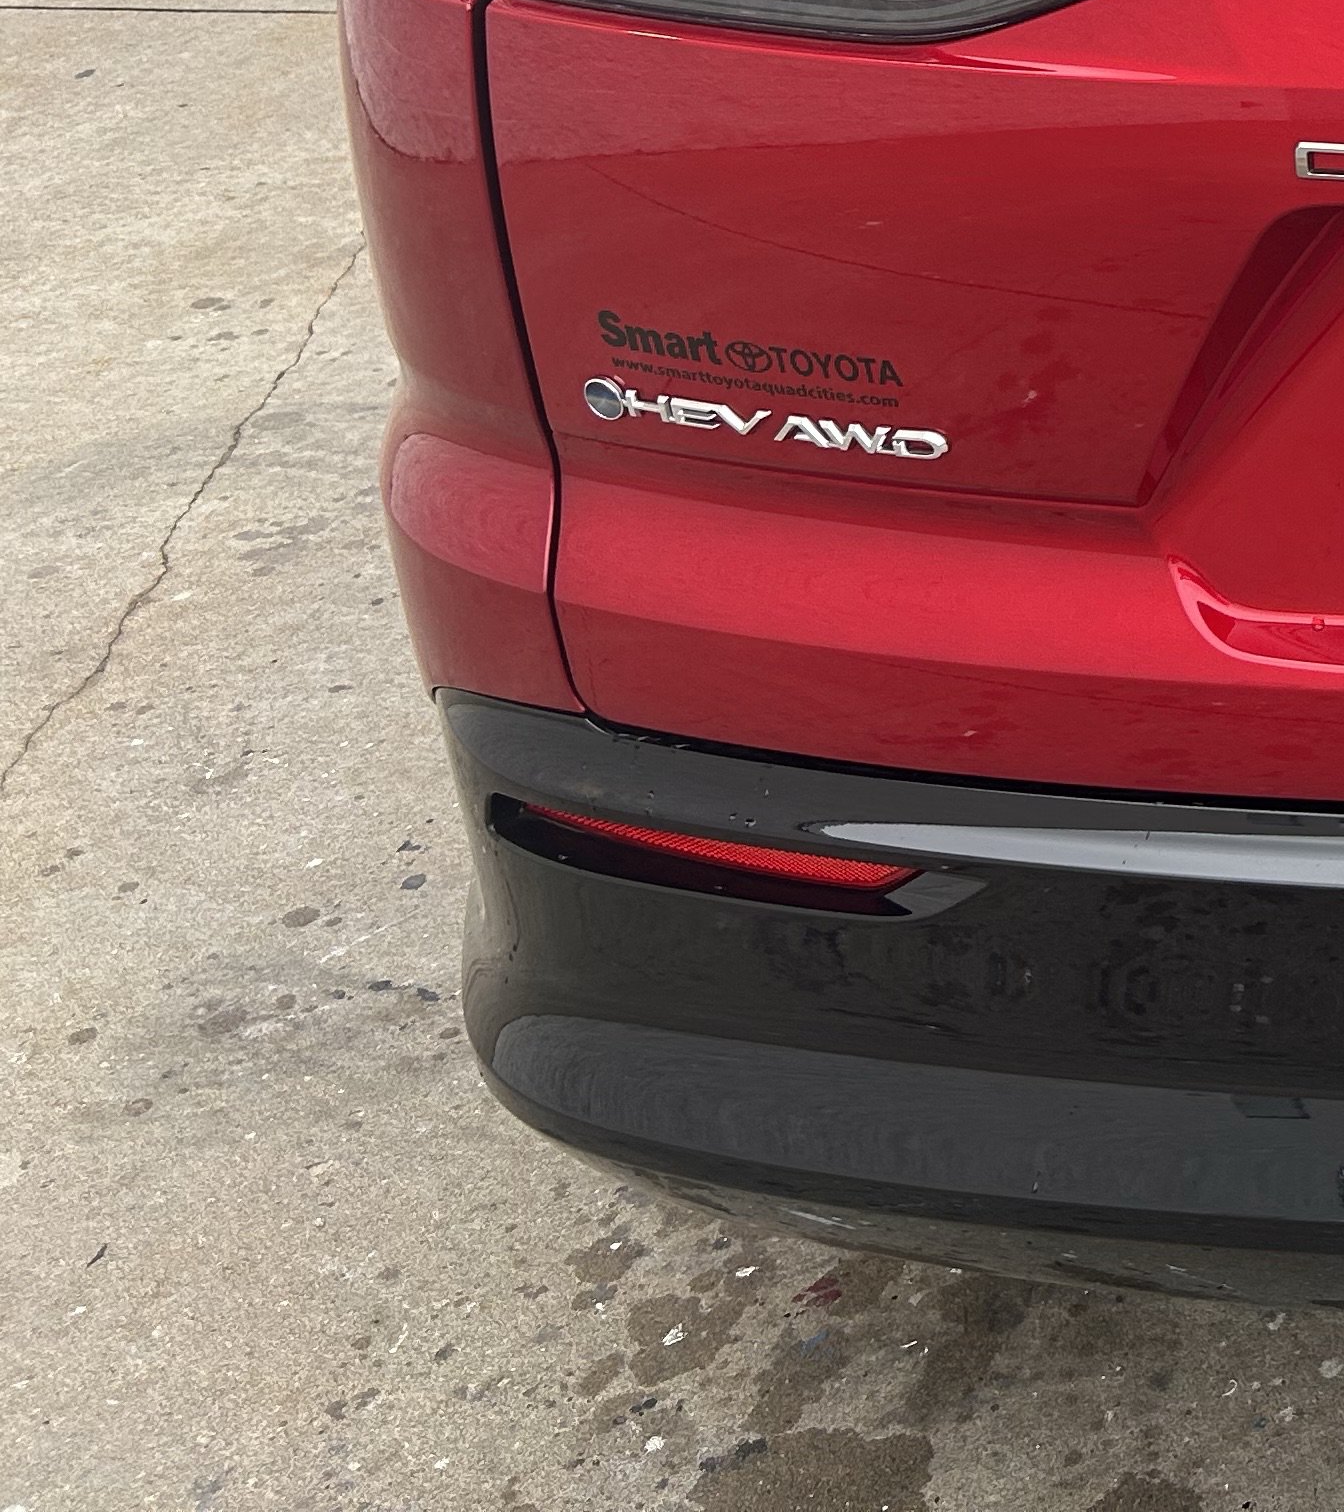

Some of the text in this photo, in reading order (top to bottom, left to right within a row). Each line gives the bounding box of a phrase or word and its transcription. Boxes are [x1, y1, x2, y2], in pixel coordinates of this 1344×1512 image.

[598, 310, 904, 387] Smart TOYOTA
[611, 356, 899, 407] www.smarttoyotaquadcities.com
[622, 388, 950, 460] HEV AWD
